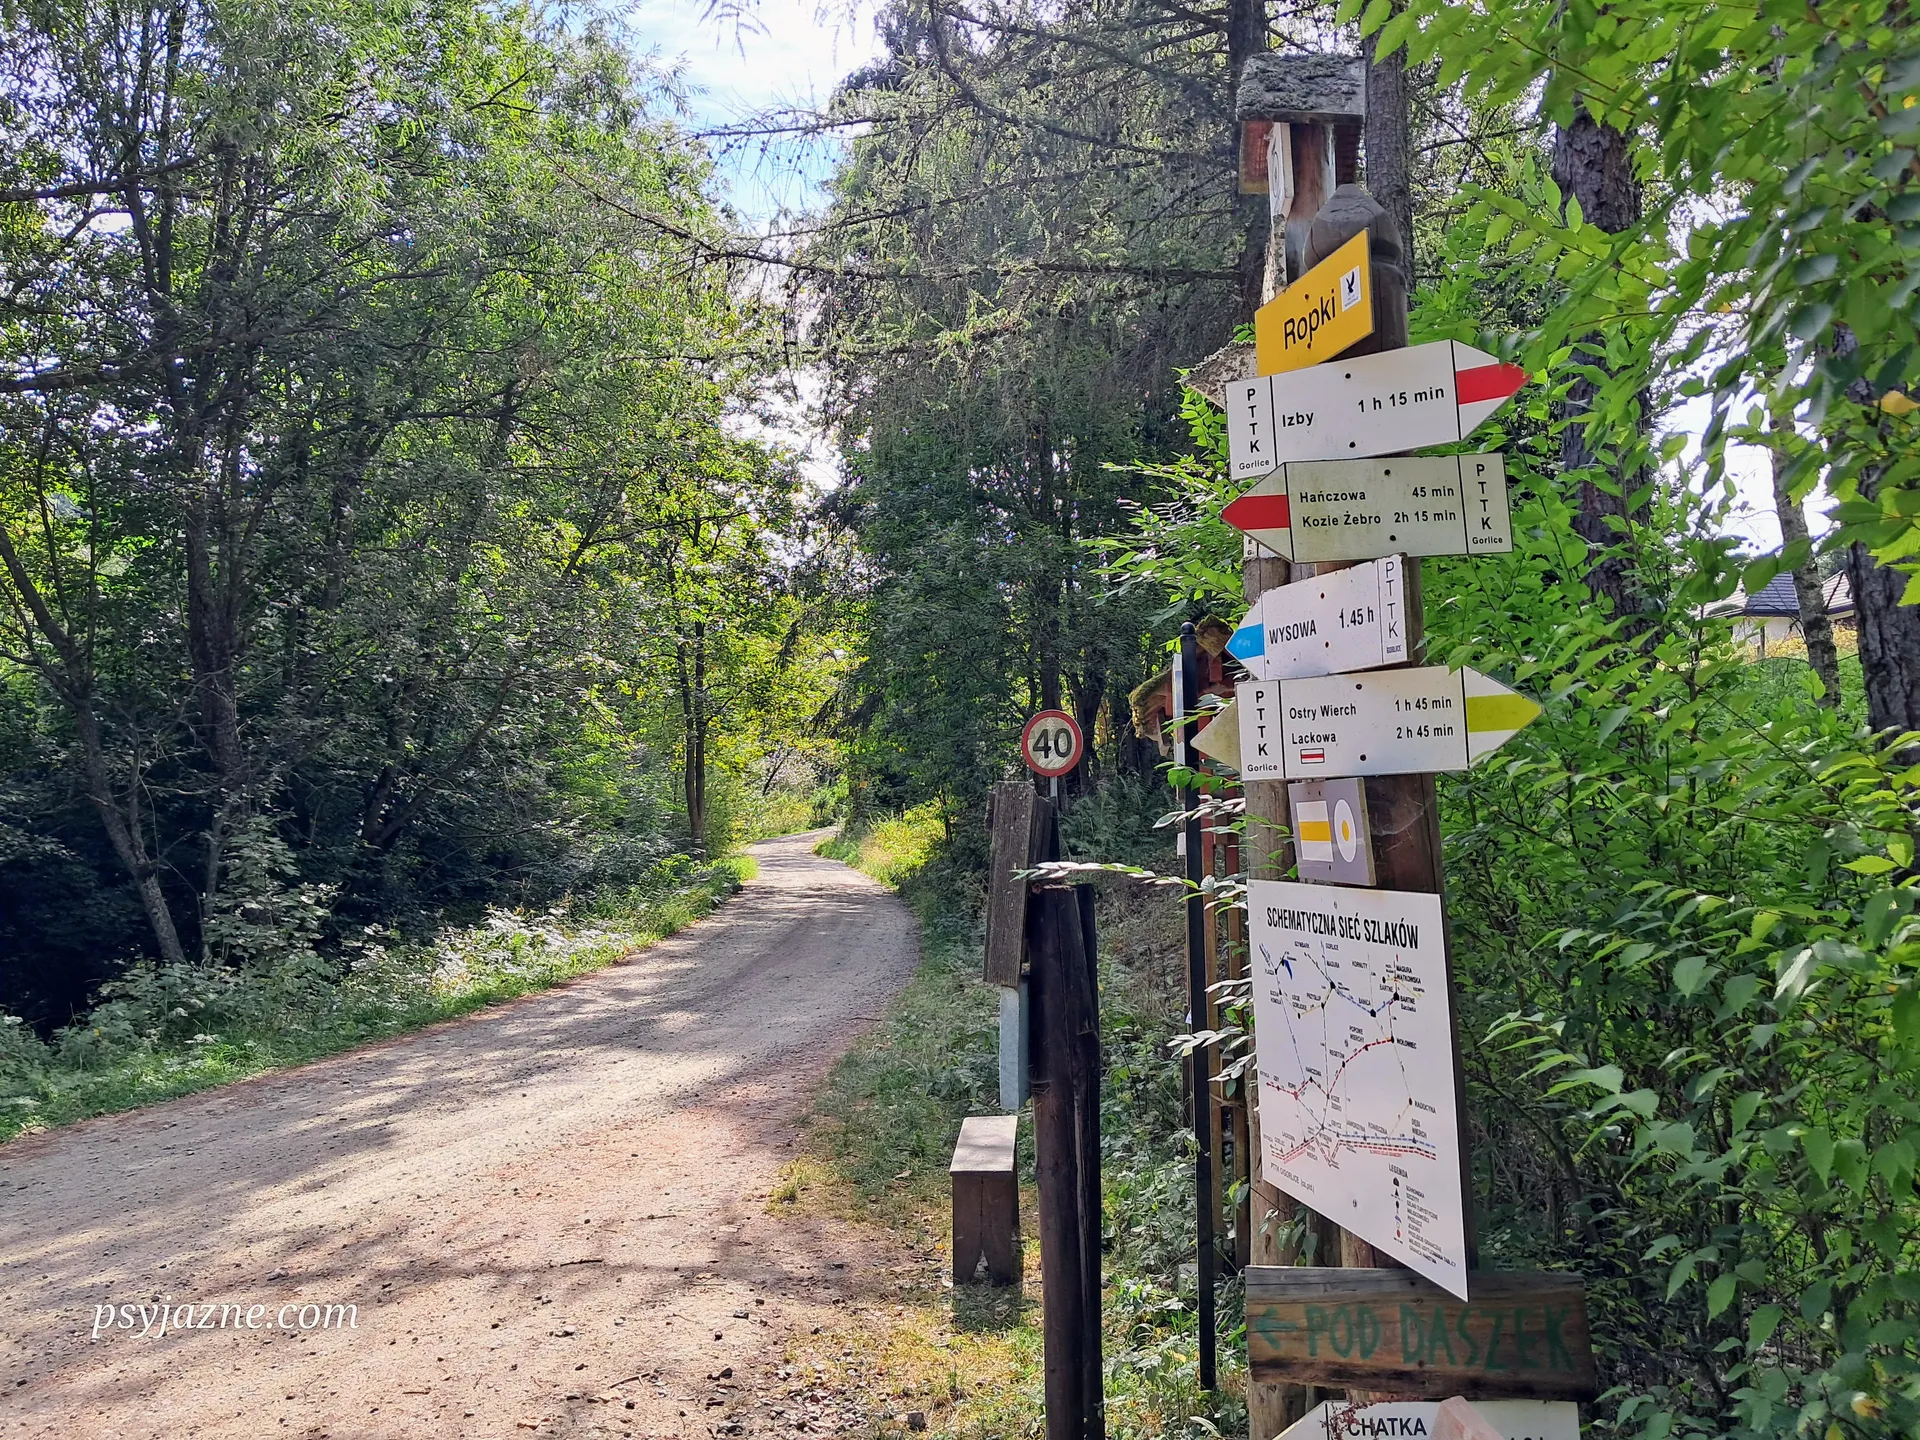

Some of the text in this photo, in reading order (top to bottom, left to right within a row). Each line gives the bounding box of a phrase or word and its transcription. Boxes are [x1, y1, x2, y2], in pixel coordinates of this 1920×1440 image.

[1283, 289, 1336, 349] Ropki
[1282, 386, 1445, 430] Izby 1 h 15 min
[1238, 458, 1270, 471] Gorlice
[1300, 486, 1455, 503] Hańczowa 45 min
[1302, 509, 1456, 528] Kozie Żebro 2h 15 min
[1472, 535, 1503, 545] Gorlice
[1268, 606, 1374, 645] WYSOWA 1.45 h
[1289, 696, 1452, 721] Ostry Wierch 1 h 45 min
[1033, 727, 1073, 759] 40
[1291, 724, 1454, 745] Lackowa 2 h 45 min
[1247, 763, 1278, 773] Gorlice
[1266, 906, 1419, 949] SCHEMATYCZNA SIEĆ SZLAKÓW
[1305, 1303, 1578, 1372] POD DASZEK
[1349, 1417, 1428, 1437] CHATKA
